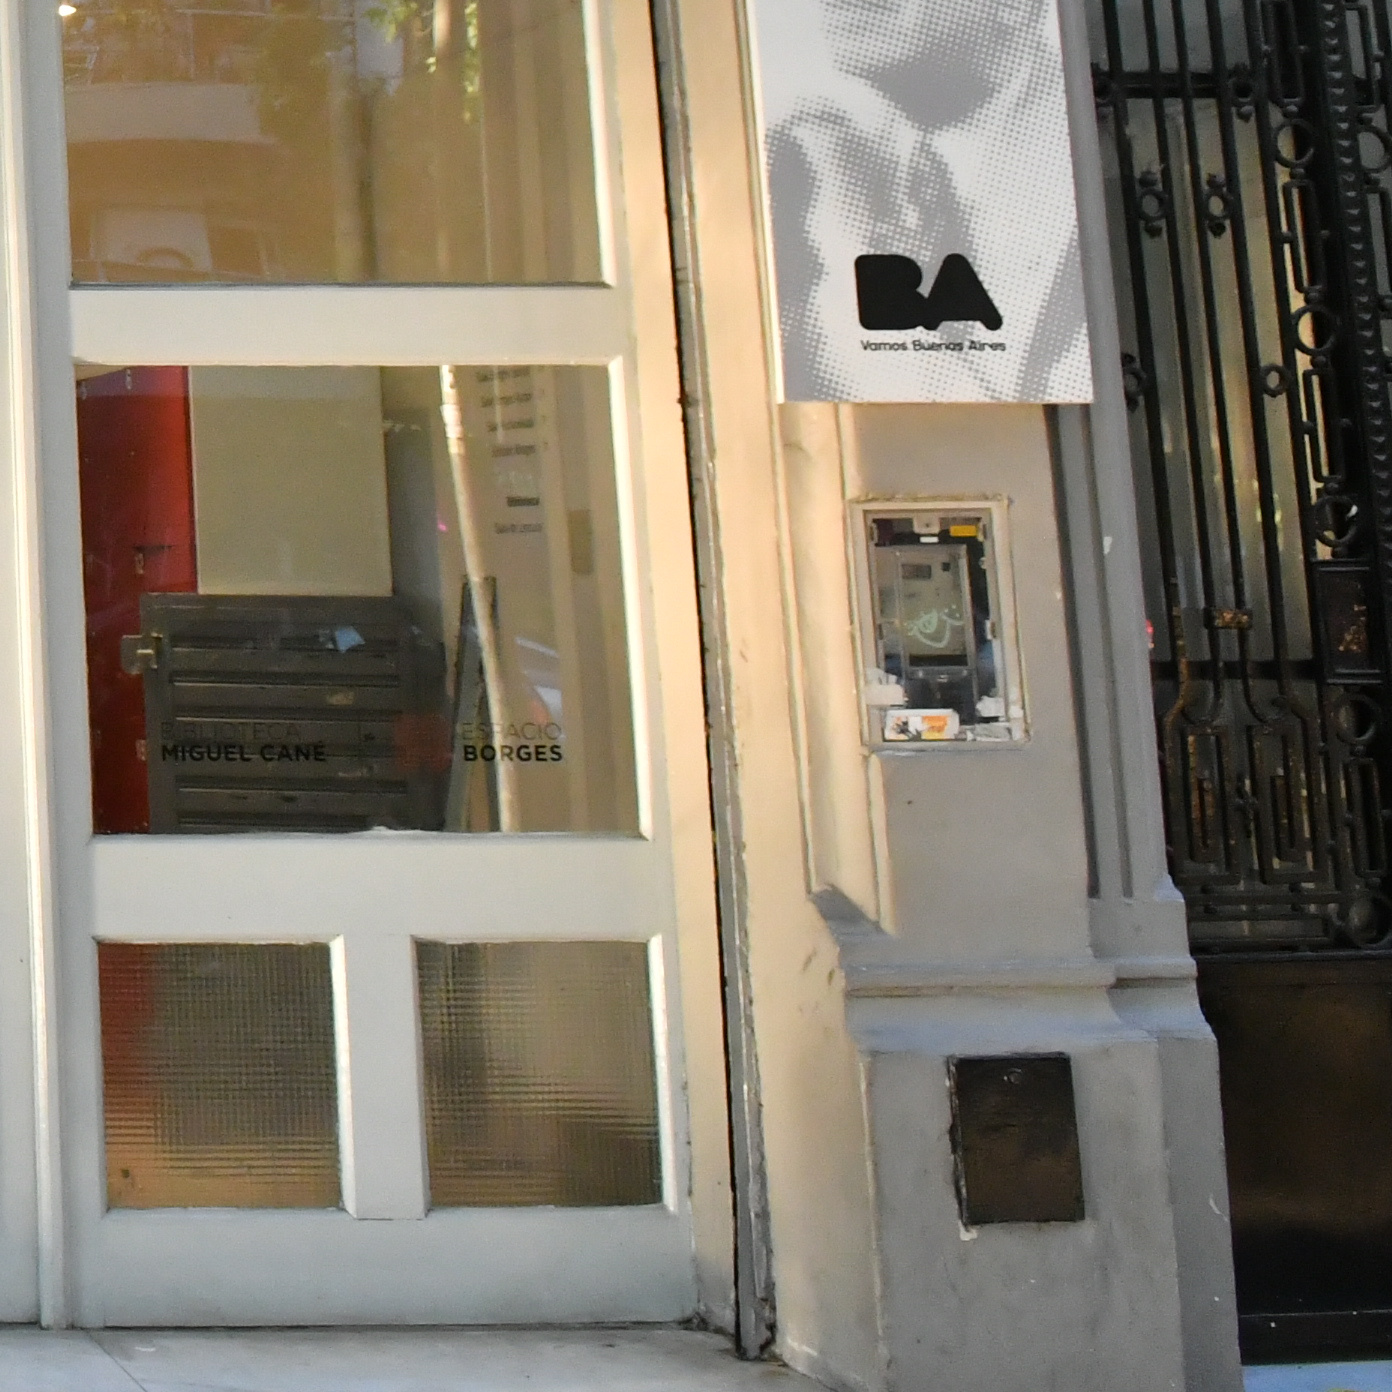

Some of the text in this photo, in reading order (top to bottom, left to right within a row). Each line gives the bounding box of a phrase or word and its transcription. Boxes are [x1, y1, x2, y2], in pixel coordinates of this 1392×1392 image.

[860, 339, 908, 352] Vamos
[968, 339, 1007, 352] Aires
[161, 739, 564, 762] MIGUEL CANÉ BORGES
